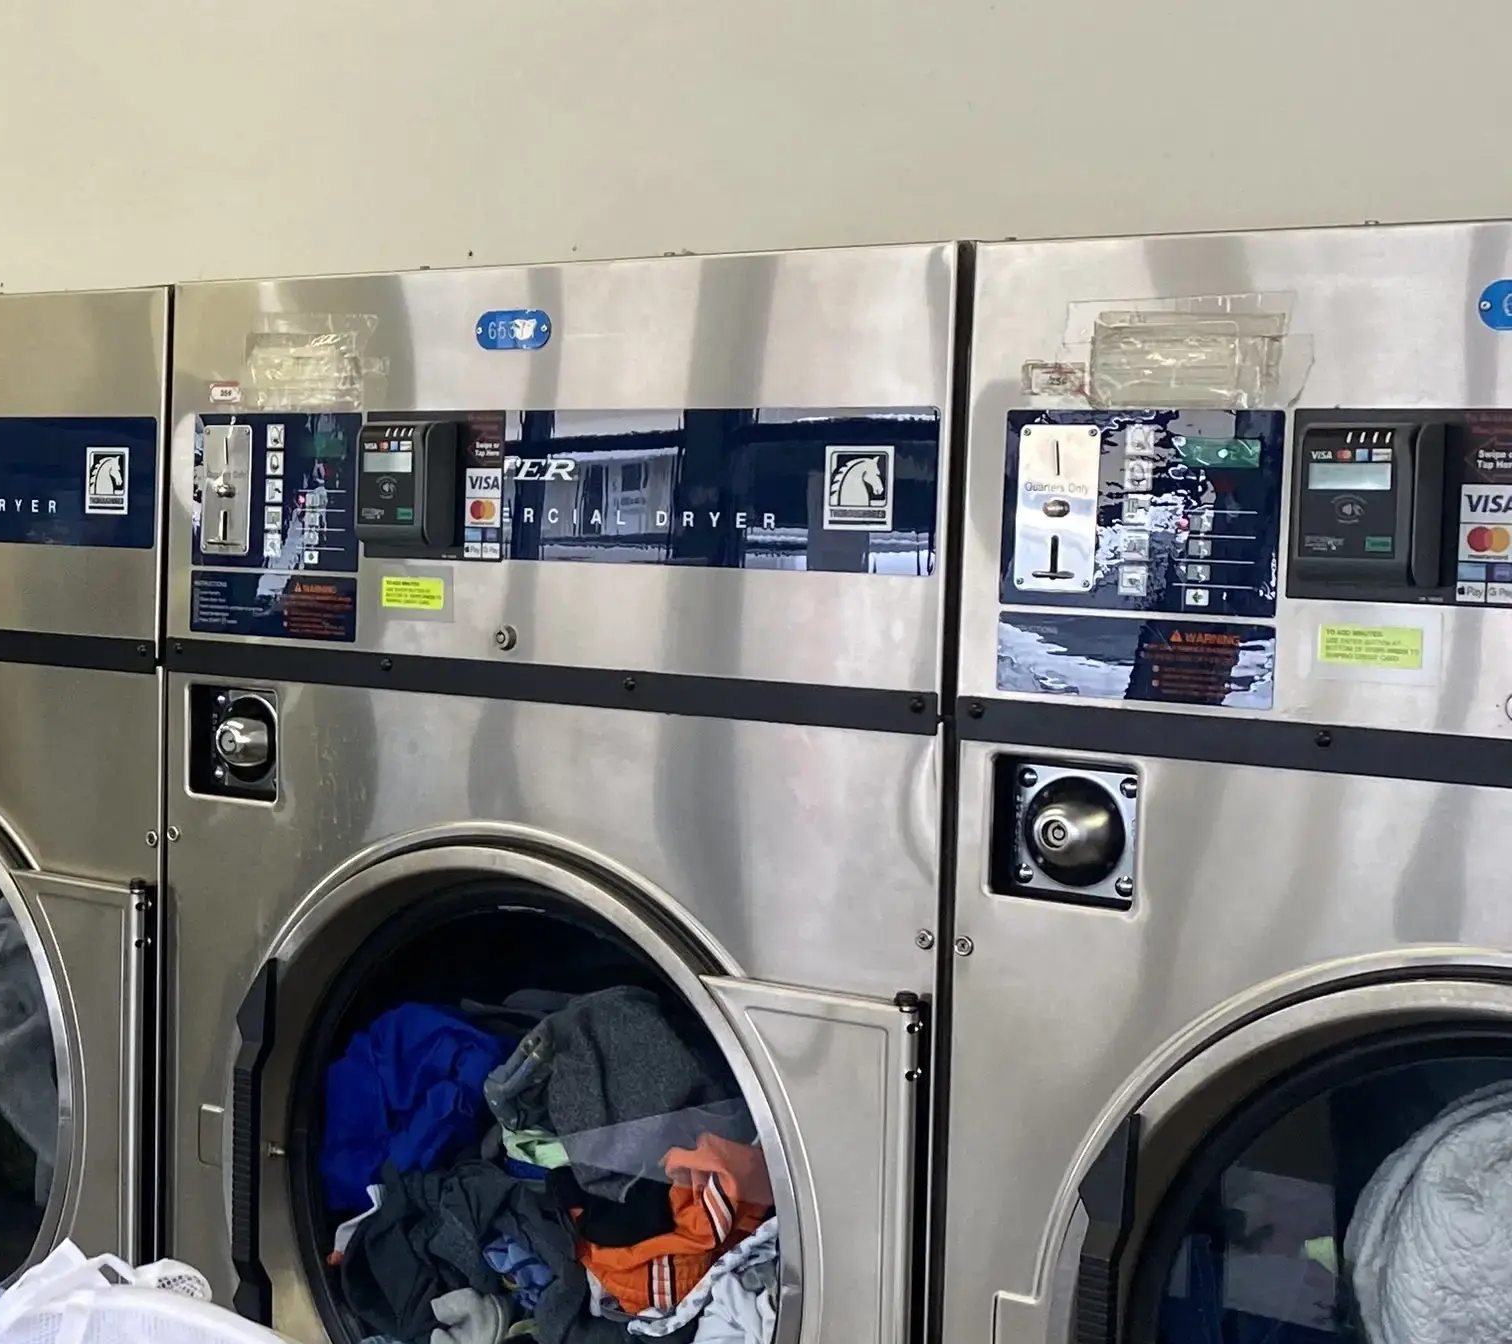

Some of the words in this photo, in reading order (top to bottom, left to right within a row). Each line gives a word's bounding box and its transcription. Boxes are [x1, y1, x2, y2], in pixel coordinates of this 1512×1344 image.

[1311, 451, 1332, 460] VISA
[469, 476, 500, 490] VISA
[1024, 480, 1065, 494] Quarters
[1068, 481, 1090, 496] Only
[1464, 494, 1512, 513] VISA
[656, 511, 776, 530] DRYER
[1466, 586, 1484, 599] Pay
[1185, 632, 1240, 645] WARNING
